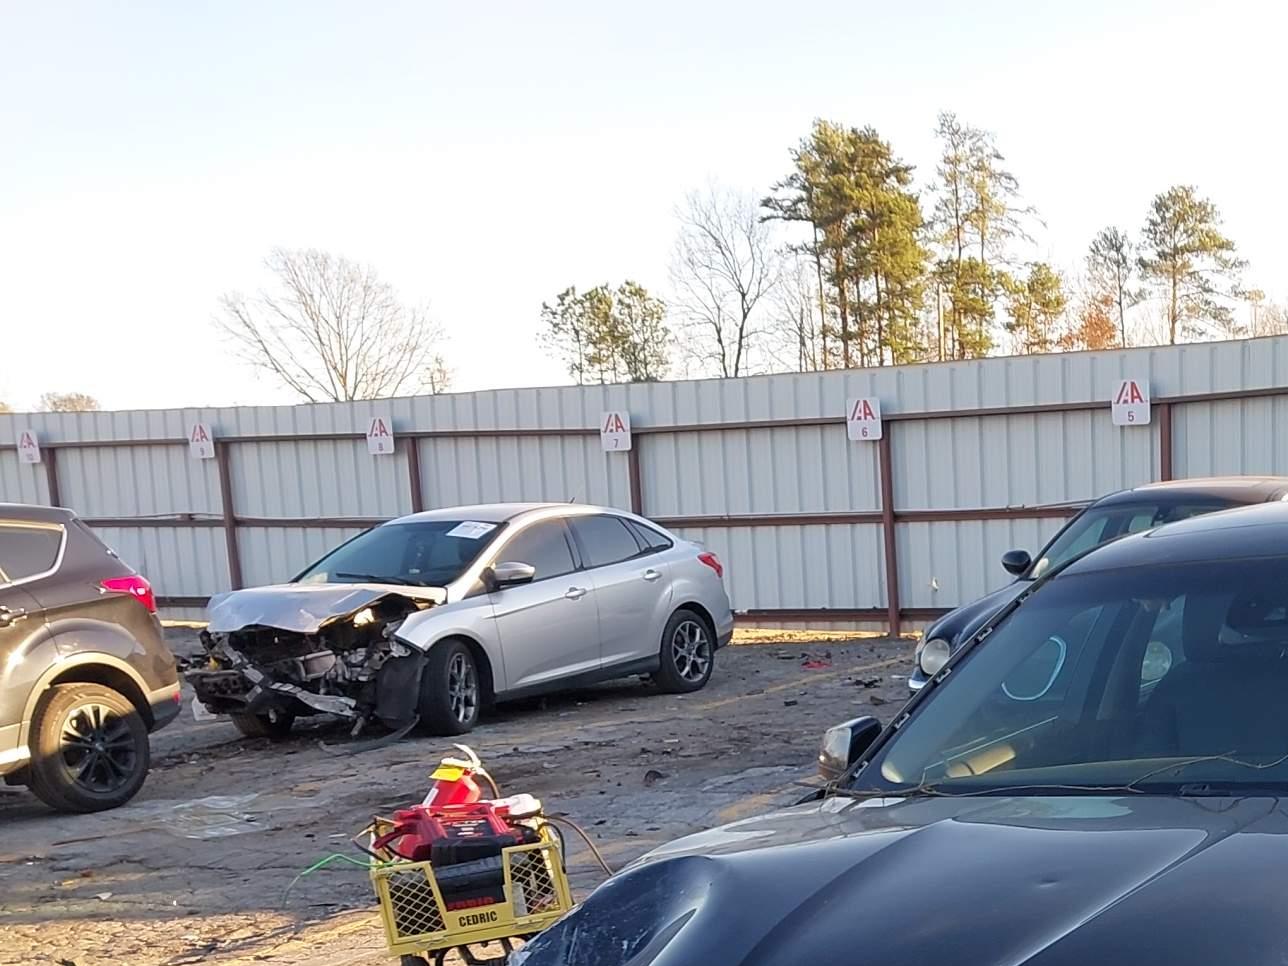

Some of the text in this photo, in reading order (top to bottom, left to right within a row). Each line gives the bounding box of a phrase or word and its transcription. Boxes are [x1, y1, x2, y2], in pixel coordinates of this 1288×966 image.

[1127, 410, 1135, 422] 5
[862, 426, 869, 438] 6
[613, 438, 620, 448] 7
[458, 910, 498, 928] CEDRIC
